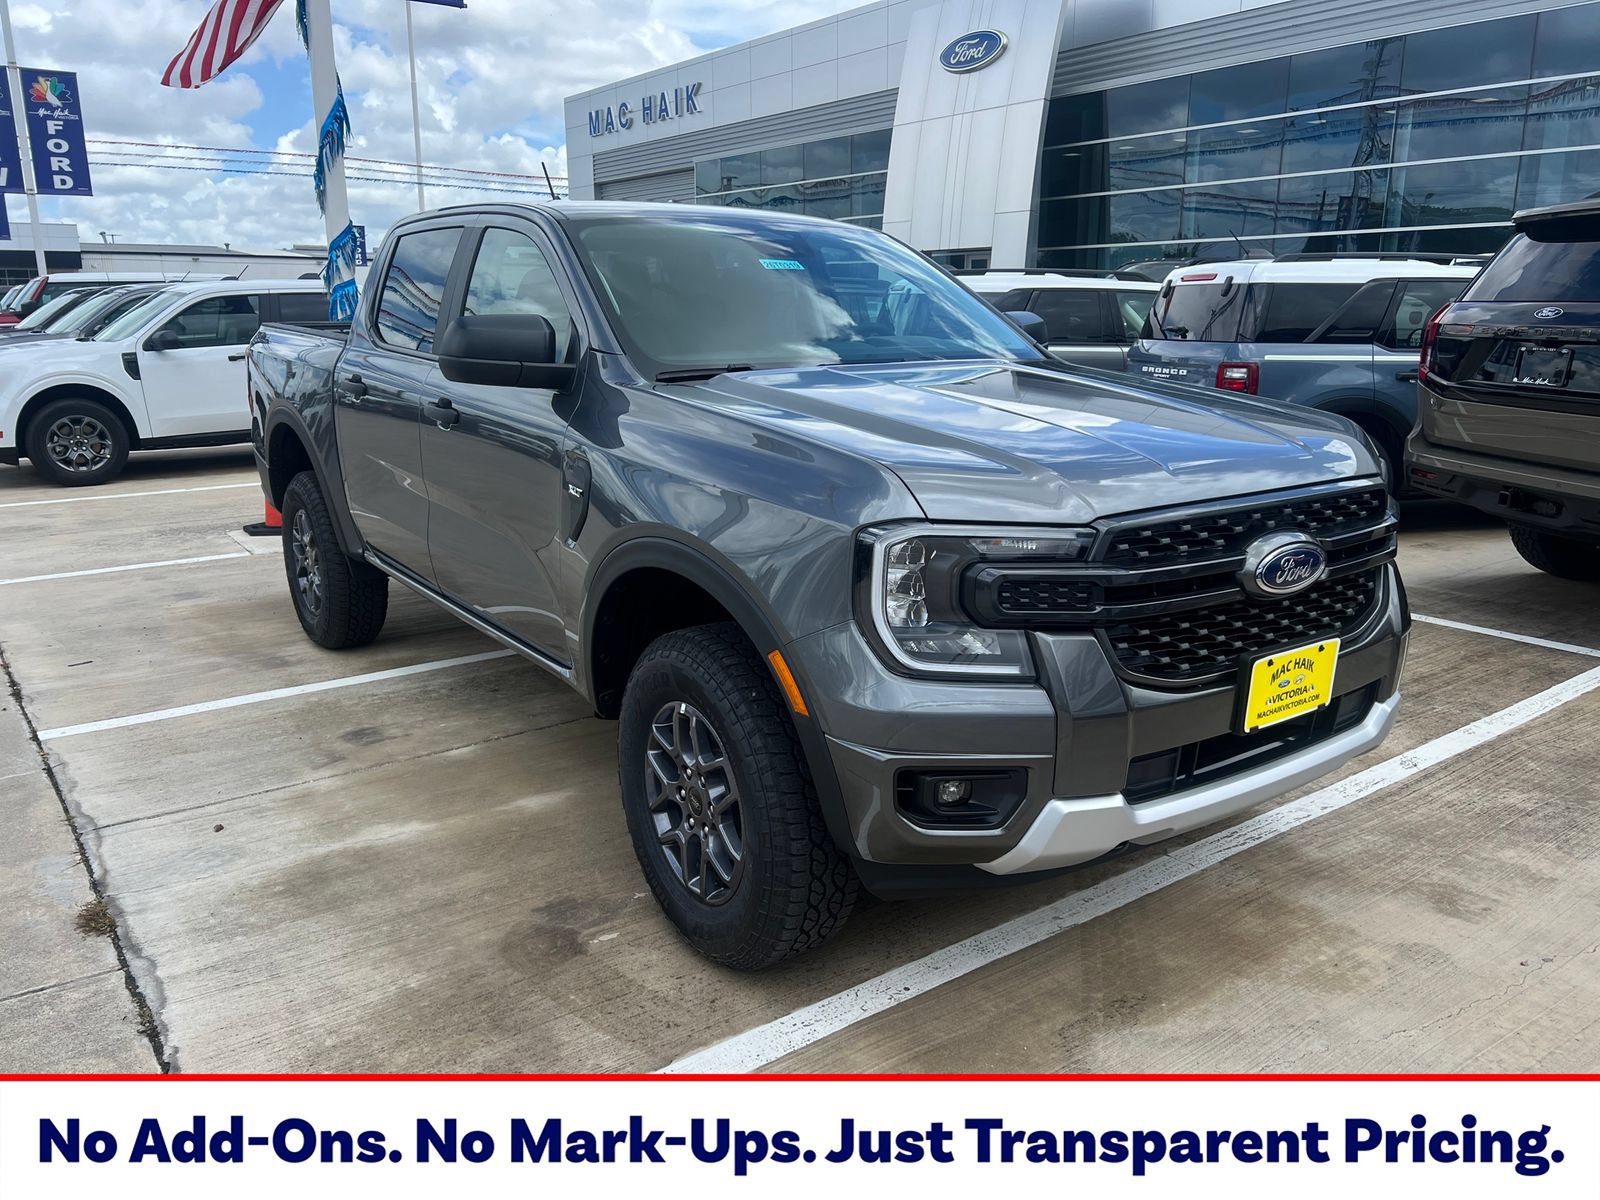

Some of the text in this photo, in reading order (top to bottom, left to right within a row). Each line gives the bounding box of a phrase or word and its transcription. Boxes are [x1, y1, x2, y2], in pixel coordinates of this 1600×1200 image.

[588, 82, 702, 137] MAC HAIK
[46, 120, 74, 190] FORD
[1142, 366, 1187, 375] BRONCO
[1270, 660, 1293, 685] MAC
[1293, 657, 1315, 672] HAIK
[1256, 694, 1320, 720] MACHAIKVICTORIA.COM
[1271, 685, 1308, 704] VICTORIA
